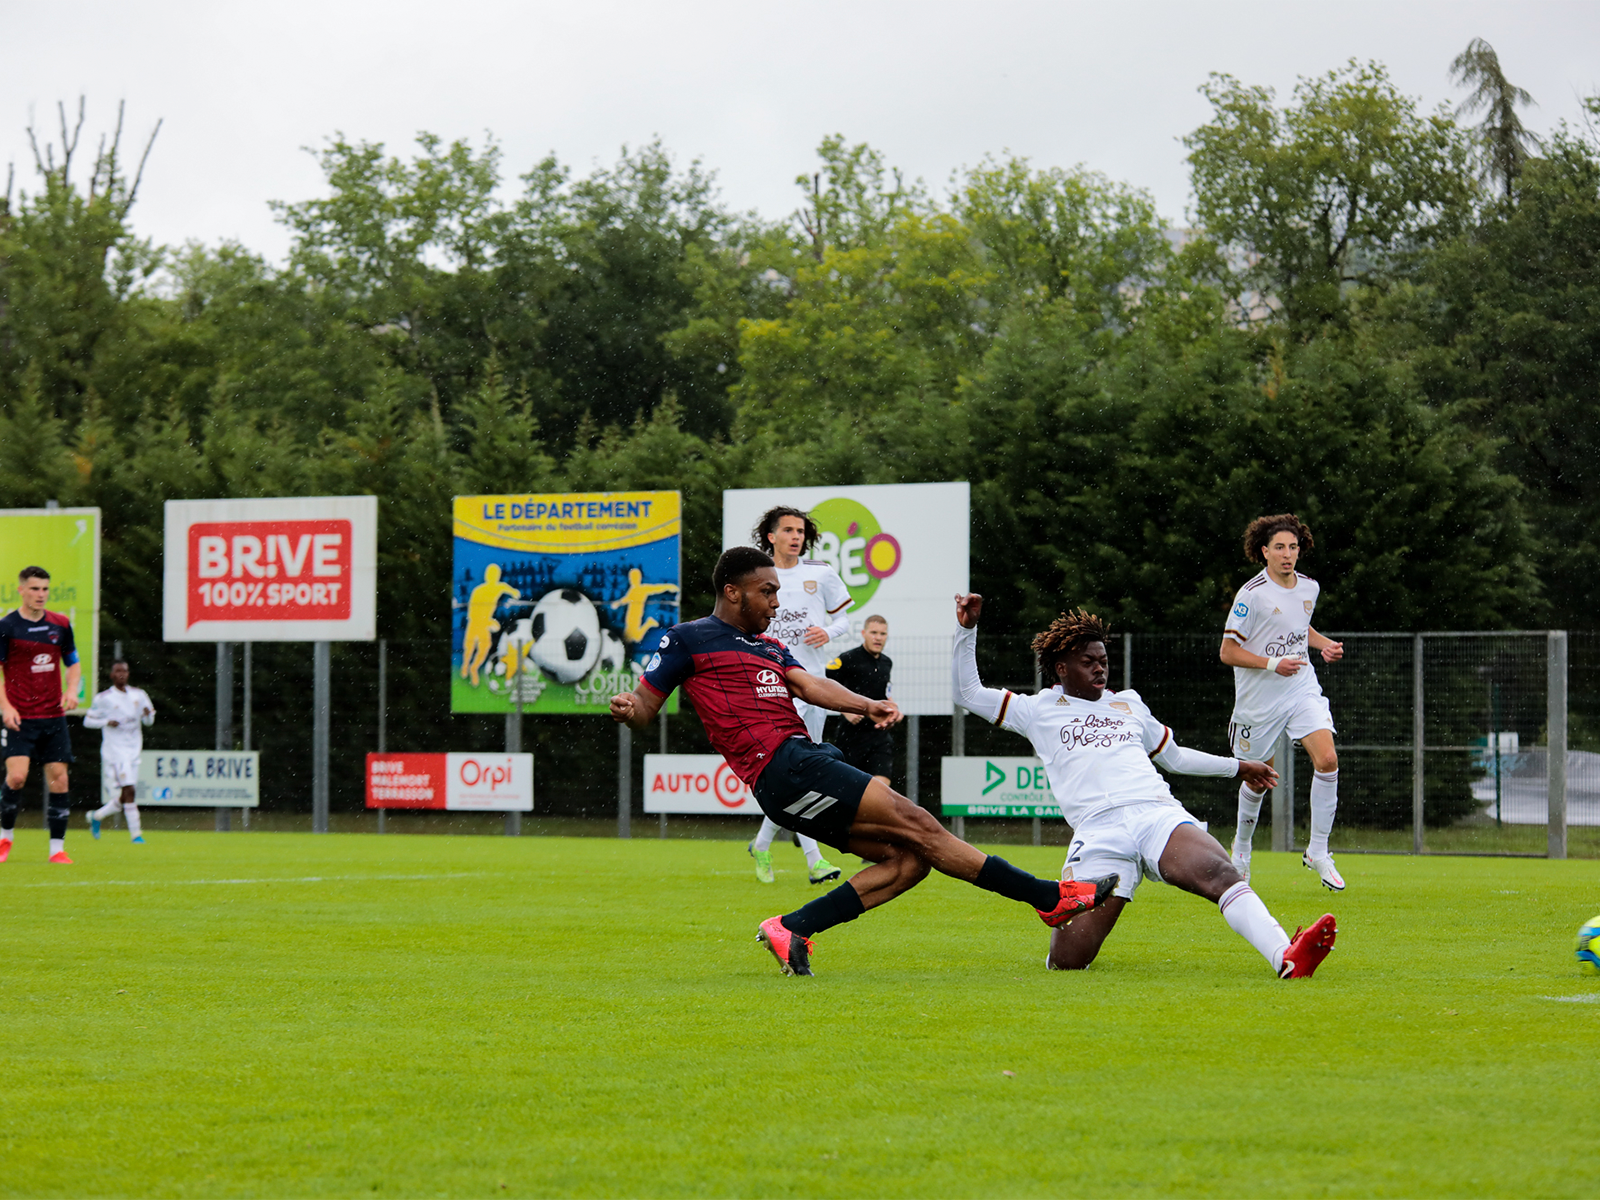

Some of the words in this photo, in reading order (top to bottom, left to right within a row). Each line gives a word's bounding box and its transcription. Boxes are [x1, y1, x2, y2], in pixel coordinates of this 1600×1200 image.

[483, 503, 506, 520] LE
[510, 498, 653, 520] DÉPARTEMENT
[1, 582, 77, 603] Lisin
[198, 582, 264, 607] 100%
[266, 582, 342, 606] SPORT
[756, 685, 788, 694] HYUNDA
[206, 757, 253, 779] BRIVE
[460, 758, 513, 791] Orpi
[651, 761, 749, 808] AUTOCO
[967, 806, 1007, 815] BRIVE
[1012, 806, 1029, 816] LA
[1034, 806, 1064, 817] GAIL
[1067, 840, 1085, 864] 2
